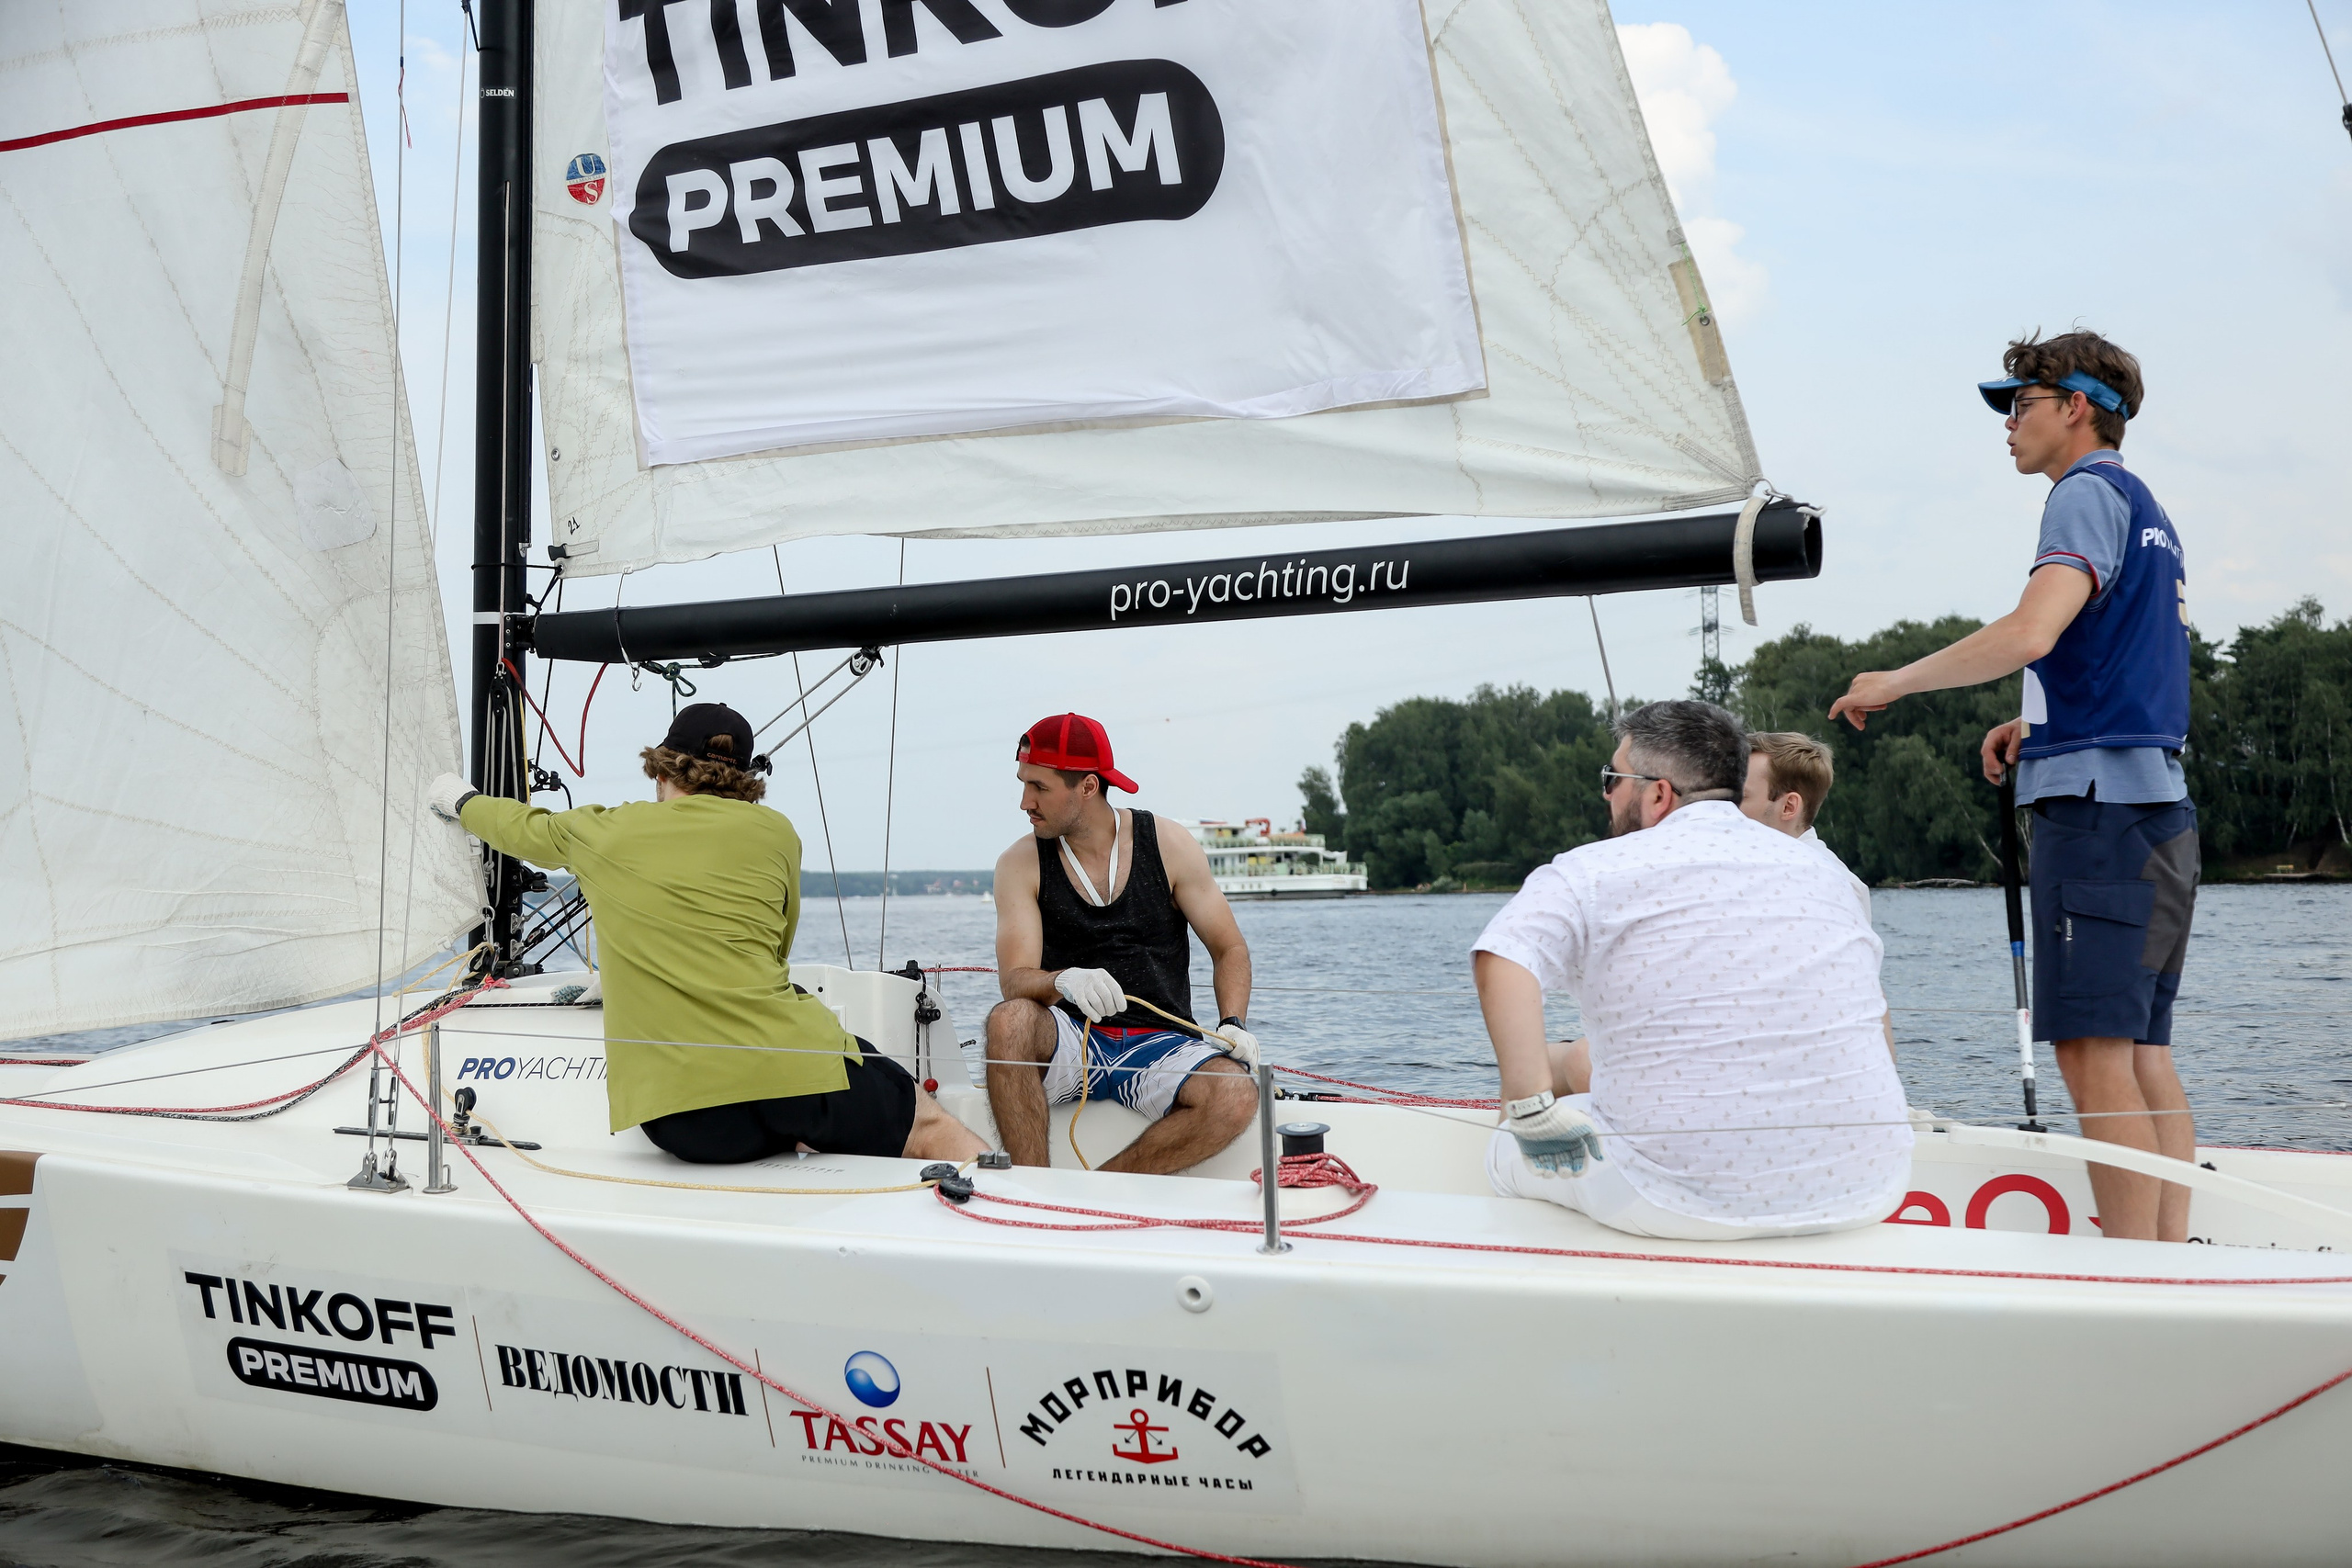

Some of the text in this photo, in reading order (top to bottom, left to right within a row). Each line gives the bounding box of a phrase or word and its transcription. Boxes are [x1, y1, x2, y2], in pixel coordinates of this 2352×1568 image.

[485, 87, 514, 97] SELDÉN
[666, 92, 1182, 253] PREMIUM
[567, 516, 580, 535] 21
[1110, 558, 1410, 621] pro-yachting.ru
[457, 1056, 608, 1080] PROYACHTI
[184, 1271, 456, 1349] TINKOFF
[238, 1346, 425, 1402] PREMIUM
[494, 1344, 750, 1416] ВЕДОМОСТИ
[789, 1410, 973, 1463] TASSAY
[1019, 1369, 1272, 1460] МОРПРИБОР
[801, 1455, 858, 1468] PREMIUM
[865, 1461, 931, 1474] DRINKING
[1053, 1468, 1253, 1491] ЛЕГЕНДАРНЫЕ ЧАСЫ
